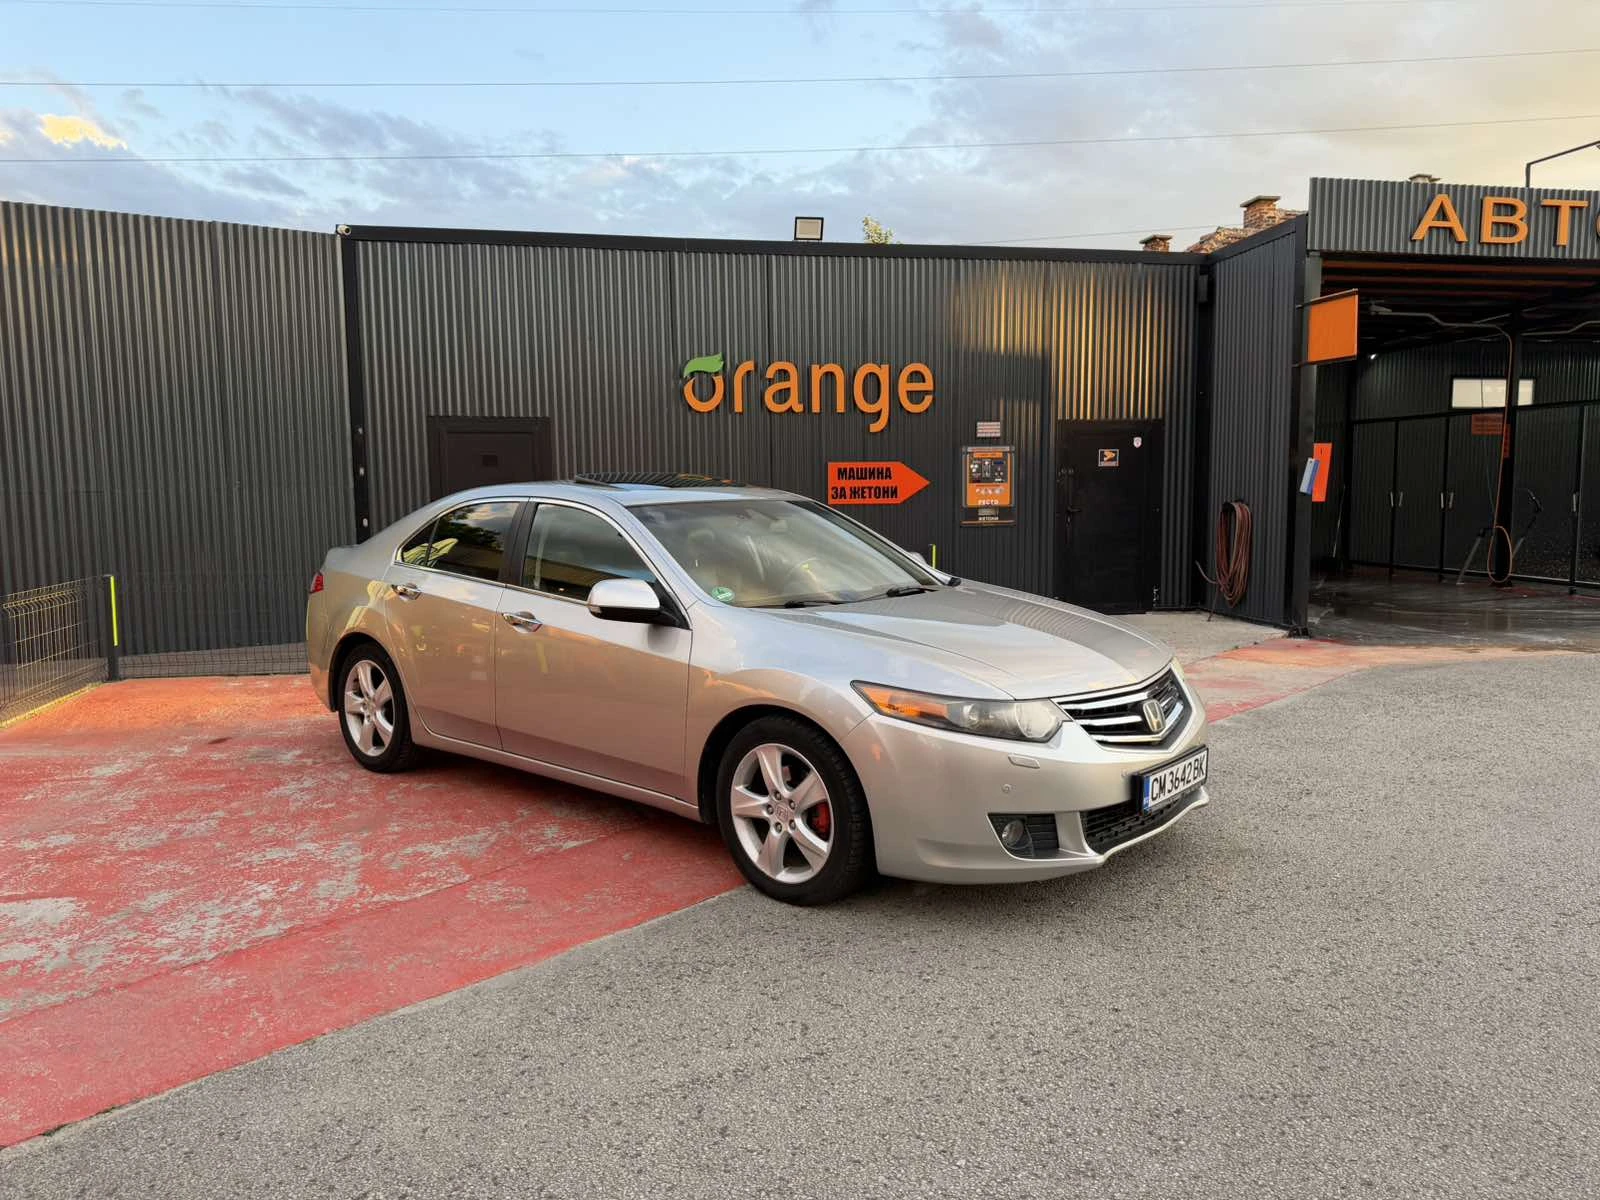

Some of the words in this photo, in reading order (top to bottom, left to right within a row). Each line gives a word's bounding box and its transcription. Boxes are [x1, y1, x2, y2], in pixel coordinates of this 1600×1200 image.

[1411, 193, 1600, 248] АВТ
[683, 360, 935, 433] orange
[837, 466, 892, 481] МАШИНА
[831, 487, 847, 499] ЗА
[849, 485, 898, 499] ЖЕТОНИ
